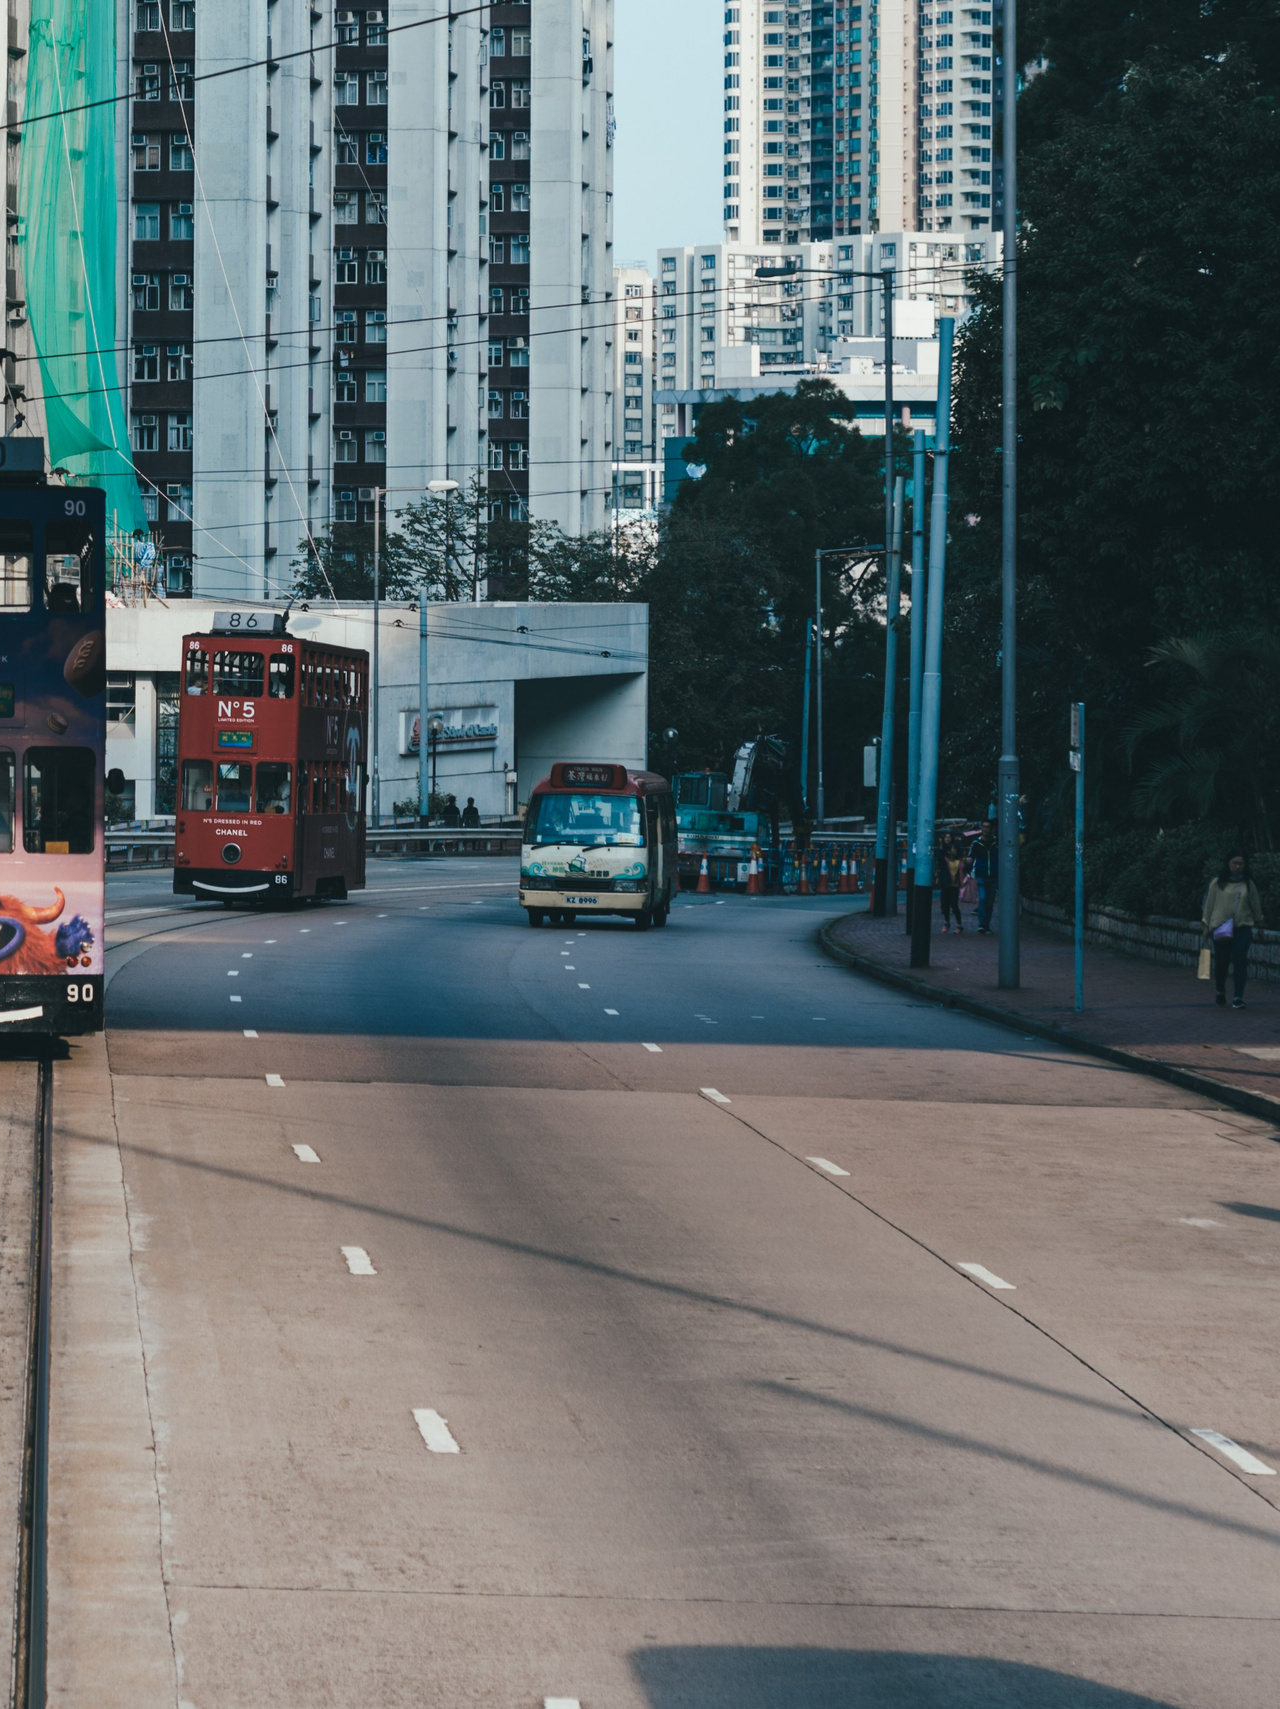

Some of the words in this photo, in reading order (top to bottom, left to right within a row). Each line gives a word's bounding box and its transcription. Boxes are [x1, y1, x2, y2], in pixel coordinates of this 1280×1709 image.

[64, 500, 86, 516] 90
[229, 613, 258, 628] 86
[189, 641, 200, 650] 86
[281, 643, 293, 653] 86
[215, 828, 248, 837] CHANEL
[275, 874, 288, 884] 86
[578, 896, 597, 904] 8996
[67, 983, 93, 1002] 90
